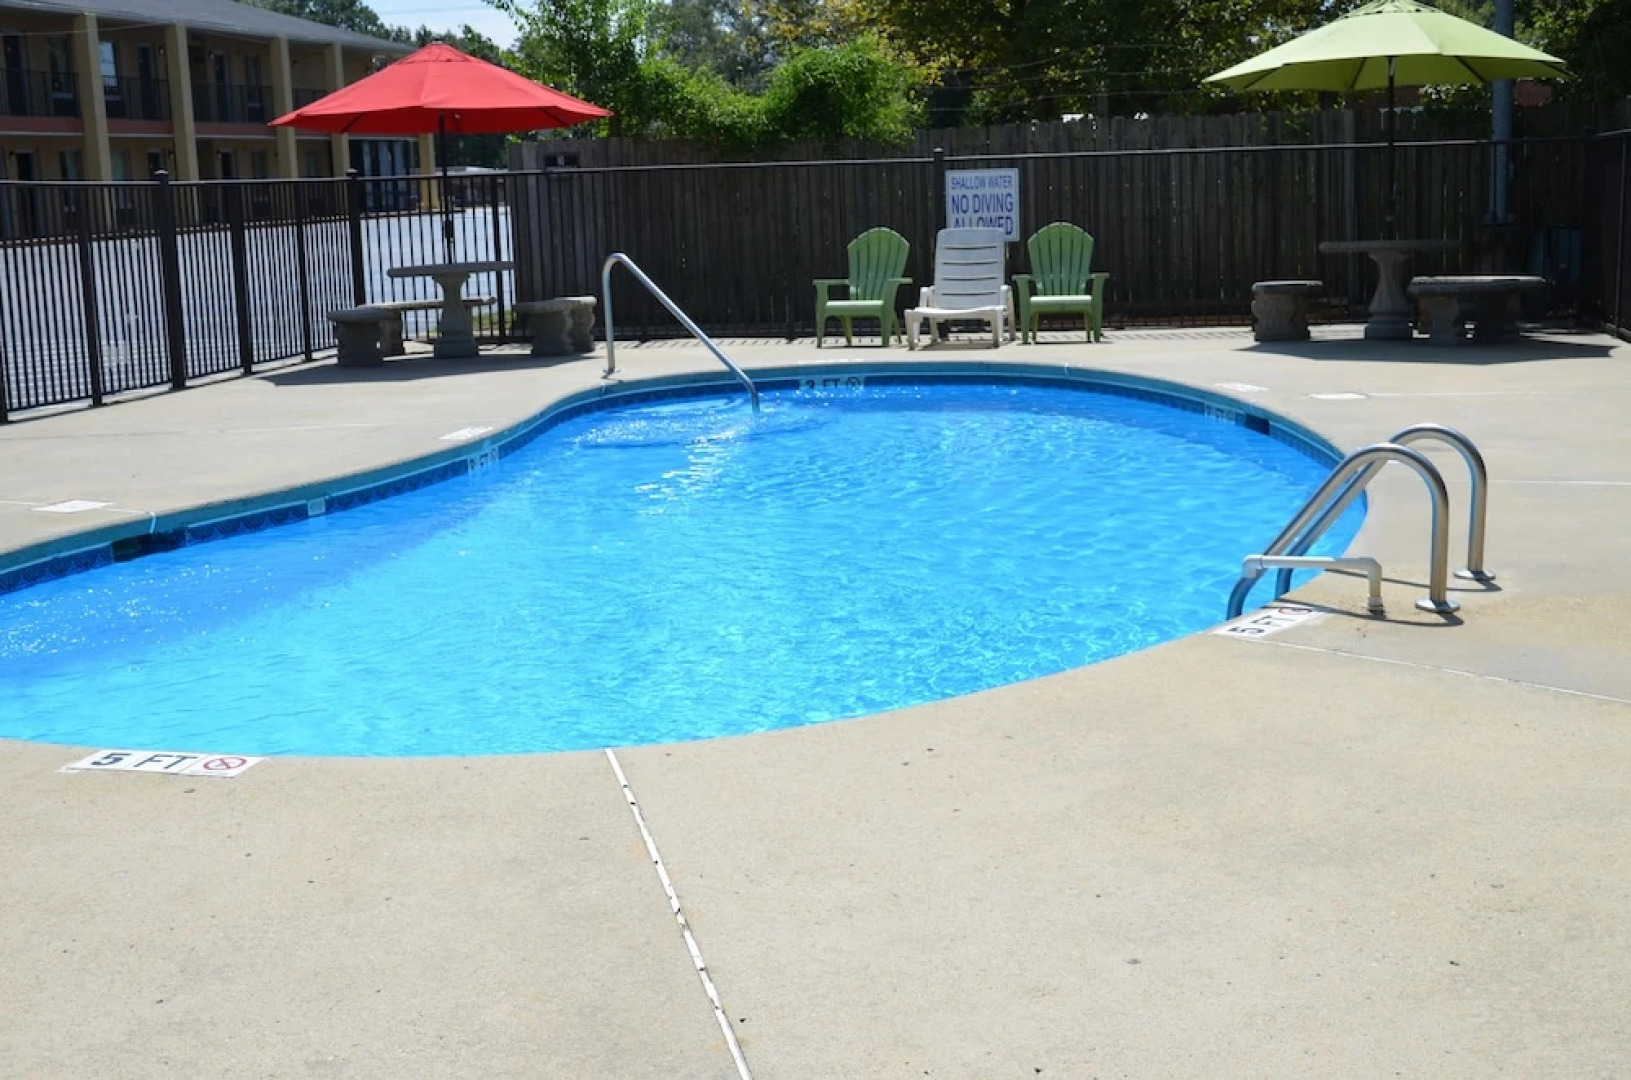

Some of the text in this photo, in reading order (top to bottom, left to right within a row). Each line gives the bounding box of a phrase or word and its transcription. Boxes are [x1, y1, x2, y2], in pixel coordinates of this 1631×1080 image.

[951, 174, 1013, 190] SHALLOW WATER
[952, 192, 1014, 214] NO DIVING
[1227, 626, 1265, 634] 5
[90, 752, 198, 770] 5 FT
